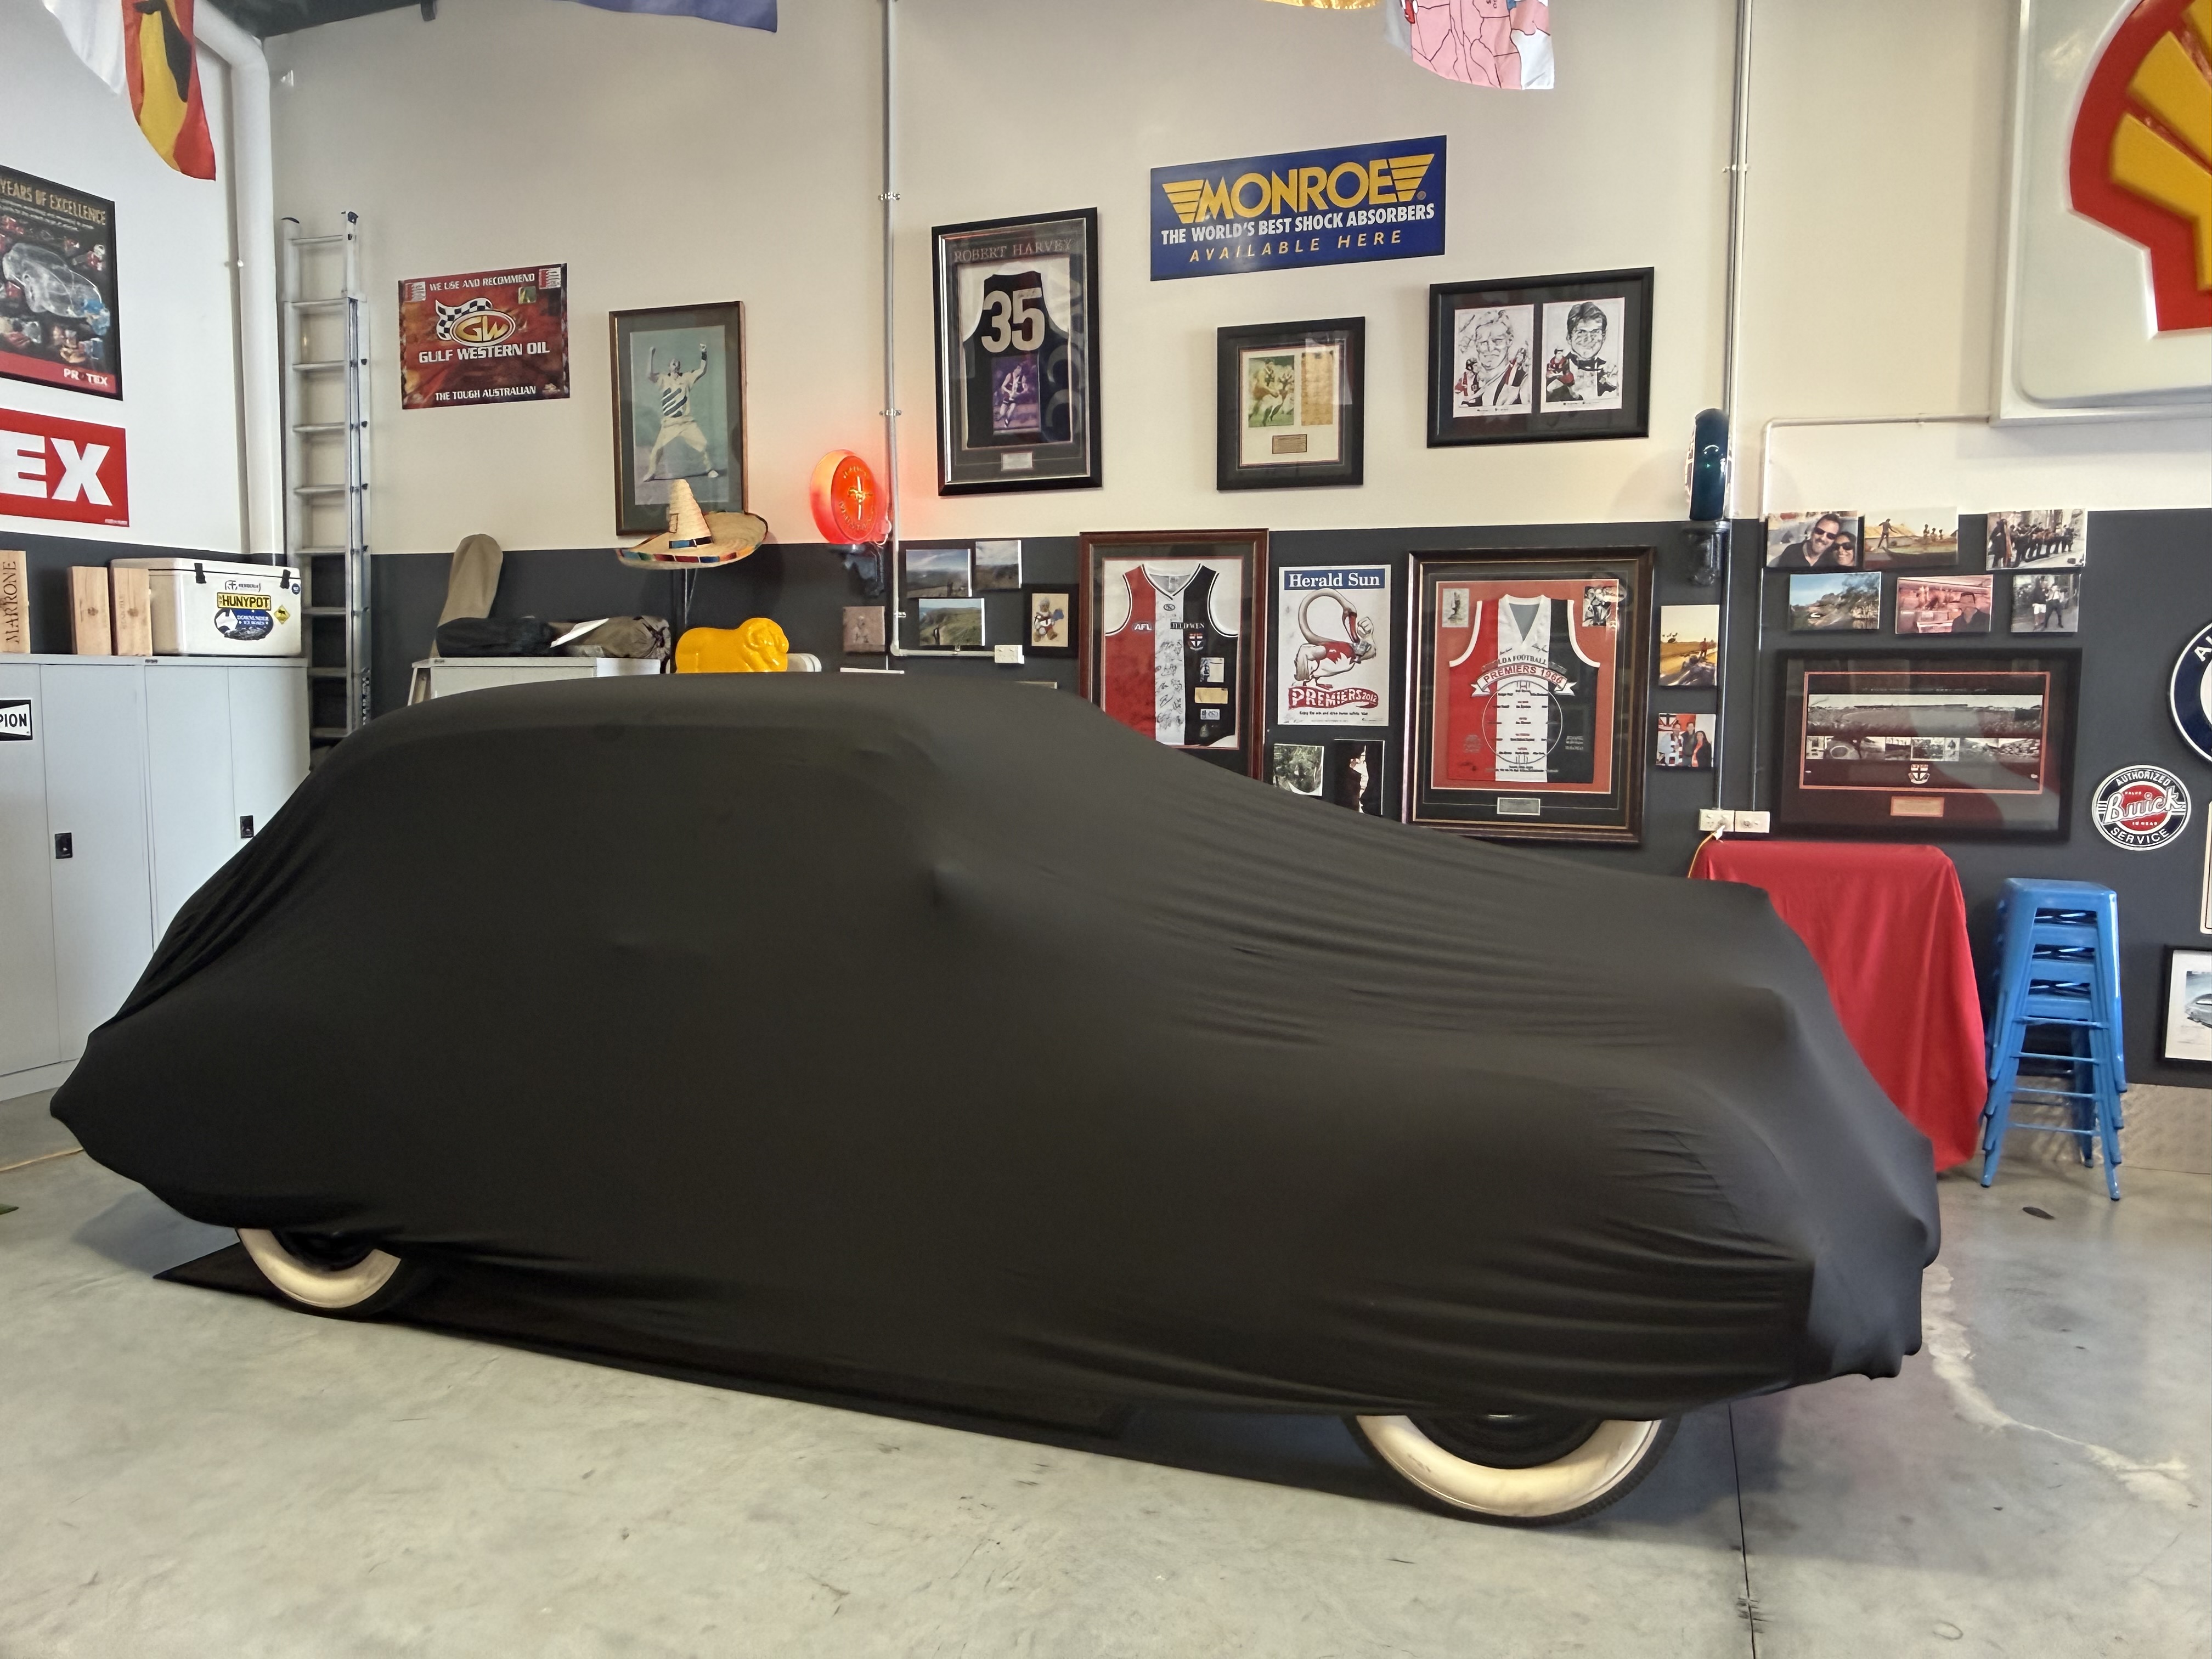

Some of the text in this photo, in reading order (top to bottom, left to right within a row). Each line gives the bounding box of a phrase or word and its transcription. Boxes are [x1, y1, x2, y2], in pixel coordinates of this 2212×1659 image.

[1194, 159, 1398, 223] MONROE
[0, 178, 33, 202] YEARS
[36, 189, 47, 206] OF
[50, 194, 106, 225] EXCELLENCE
[1161, 202, 1435, 245] THE WORLD'S BEST SHOCK ABSORBERS
[953, 239, 1072, 262] ROBERT HARVEY
[1189, 230, 1402, 263] AVAILABLE HERE
[430, 273, 535, 292] WE USE AND RECOMMEND
[455, 315, 510, 342] GW
[981, 287, 1045, 353] 35
[419, 341, 550, 363] GULF WESTERN OIL
[435, 385, 537, 401] THE TOUGH AUSTRALIAN
[1289, 572, 1380, 588] Herald Sun
[222, 595, 270, 608] HUNYPOT
[1513, 654, 1547, 665] FOOTBALL
[1483, 665, 1537, 683] PREMIERS
[1540, 669, 1563, 684] 1966
[1291, 688, 1378, 707] PREMIERS 2012
[2115, 770, 2171, 786] AUTHORIZED
[2102, 785, 2186, 826] Buick
[2111, 827, 2169, 844] SERVICE
